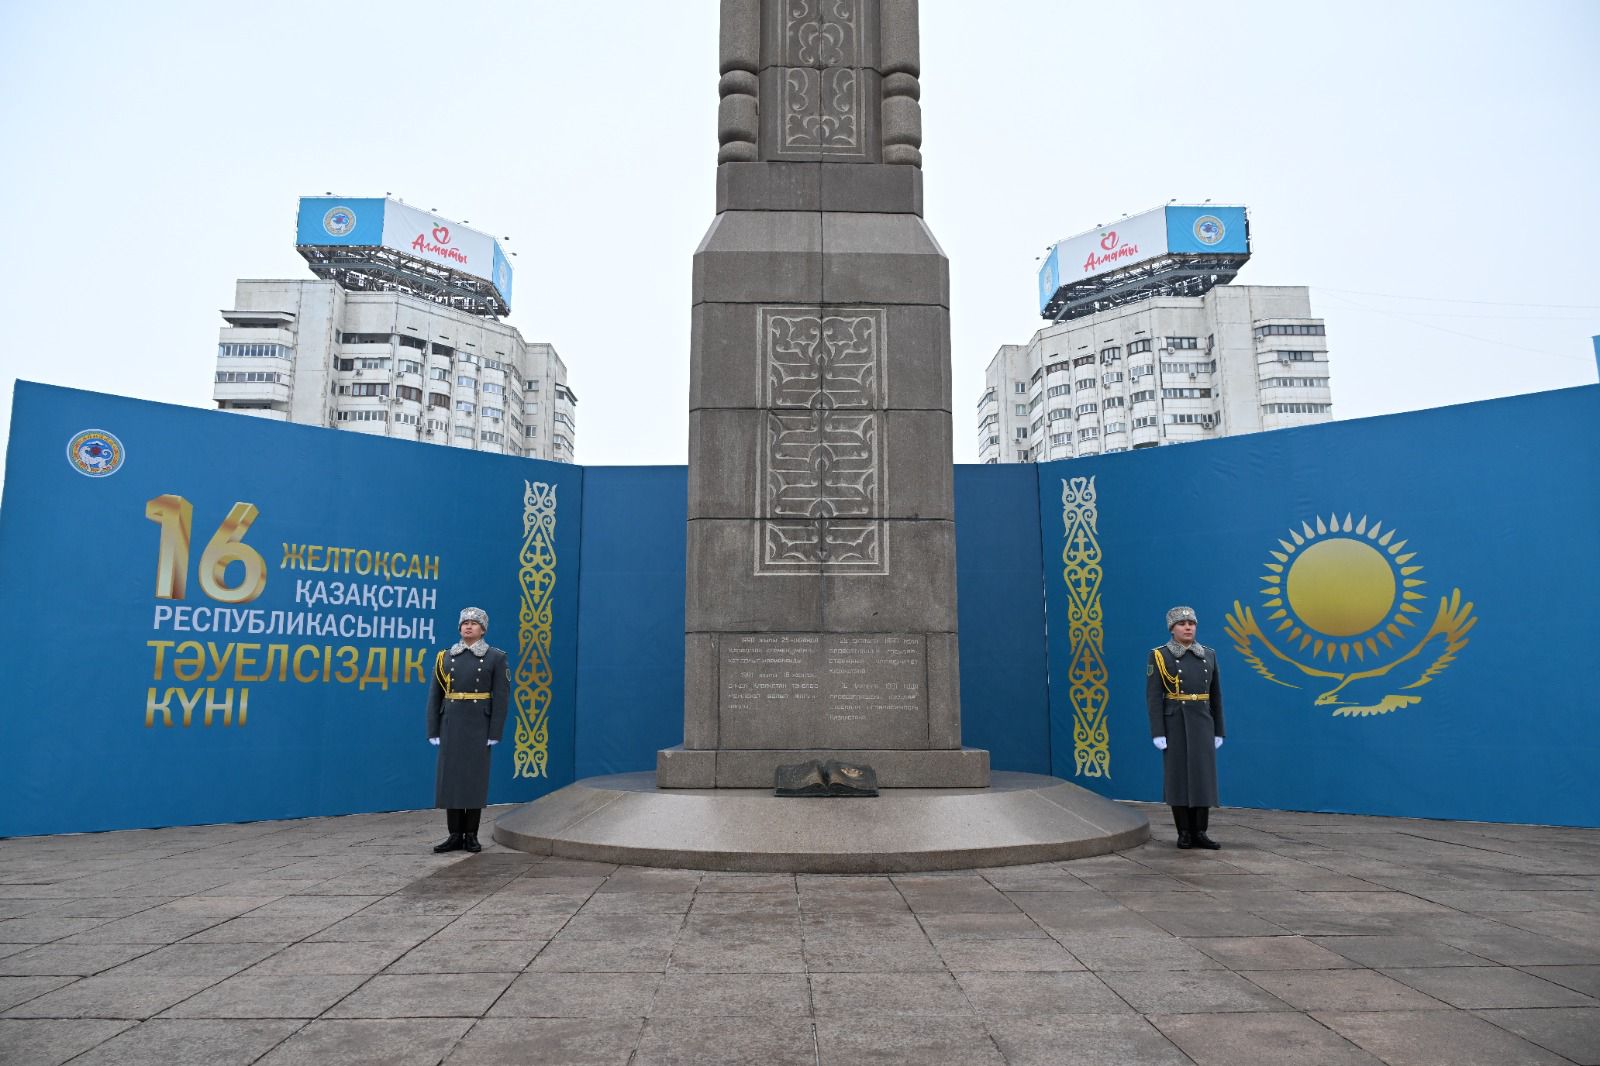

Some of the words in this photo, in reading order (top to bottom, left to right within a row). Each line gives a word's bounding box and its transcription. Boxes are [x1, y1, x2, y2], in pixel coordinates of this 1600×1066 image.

[411, 233, 468, 264] Алматы
[1084, 243, 1138, 272] Алматы
[145, 493, 267, 604] 16
[280, 542, 440, 581] ЖЕЛТОҚСАН
[295, 579, 437, 611] ҚАЗАҚСТАН
[153, 605, 436, 645] РЕСПУБЛИКАСЫНЫҢ
[146, 640, 427, 691] ТӘУЕЛСІЗДІК
[144, 686, 249, 728] КҮНІ
